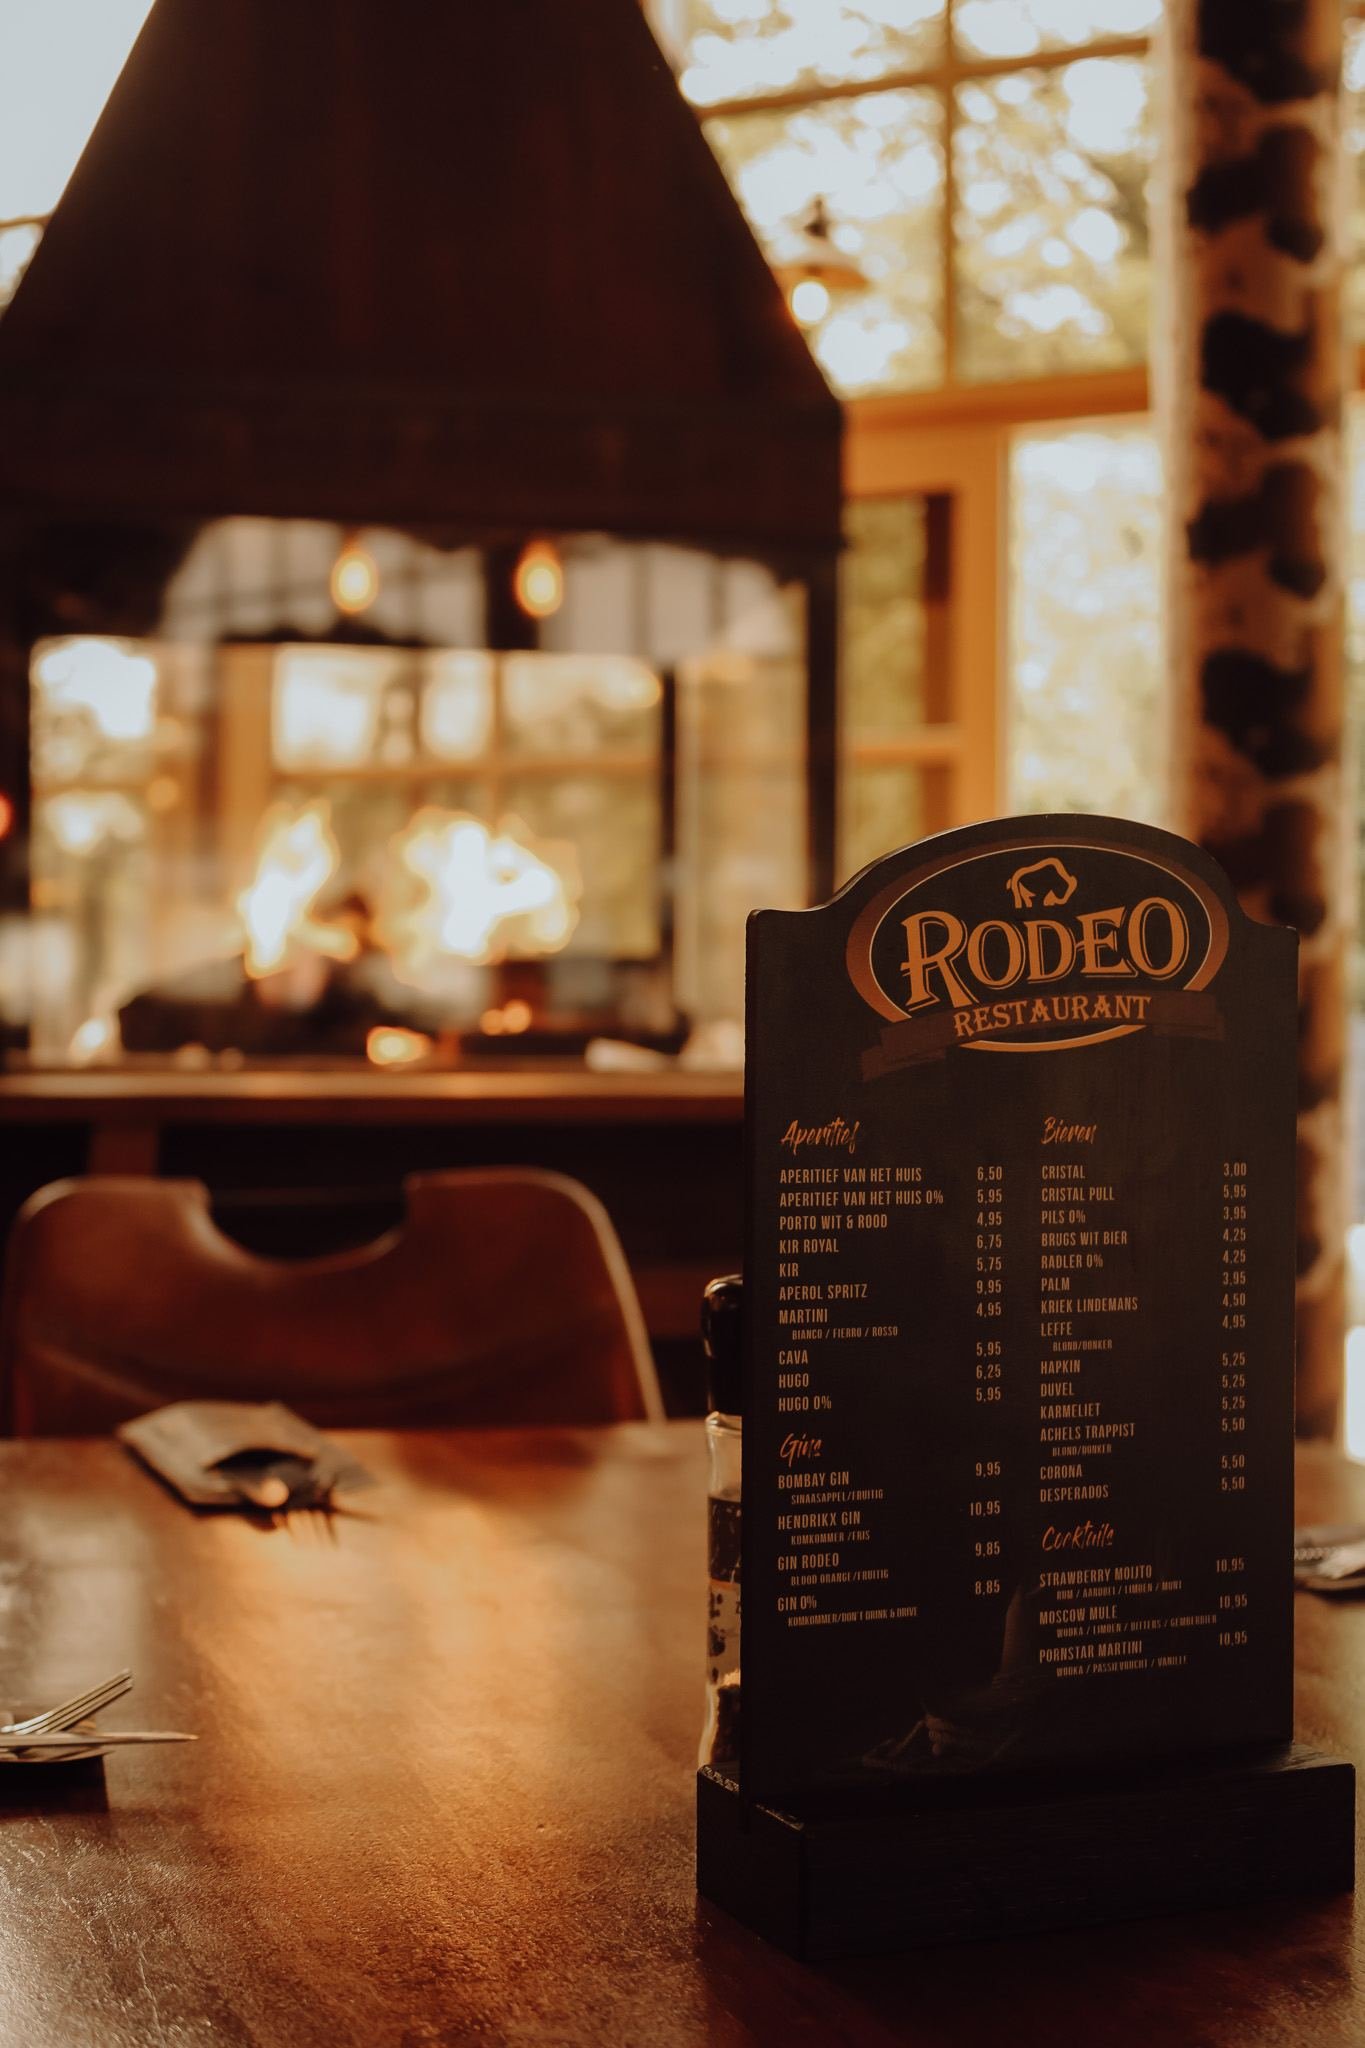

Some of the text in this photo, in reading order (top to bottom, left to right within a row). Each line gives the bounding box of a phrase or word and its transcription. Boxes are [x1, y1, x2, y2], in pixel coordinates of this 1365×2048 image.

[901, 896, 1190, 1011] RODEO
[953, 995, 1152, 1038] RESTAURANT
[780, 1117, 860, 1155] Aperitief
[1041, 1117, 1097, 1144] Bieren
[780, 1168, 922, 1184] APERITIEF VAN HET HUIS
[977, 1166, 1003, 1182] 6,50
[1042, 1165, 1085, 1180] CRISTAL
[1223, 1163, 1247, 1177] 3,00
[780, 1190, 944, 1207] APERITIEF VAN HET HUIS 0%
[977, 1188, 1002, 1204] 5,95
[1042, 1187, 1114, 1202] CRISTAL PULL
[1223, 1184, 1247, 1199] 5,95
[977, 1212, 1002, 1227] 4,95
[1041, 1209, 1086, 1224] PILS 0%
[1223, 1206, 1246, 1221] 3,95
[780, 1214, 888, 1230] PORTO WIT & ROOD
[977, 1234, 1002, 1250] 6,75
[1041, 1231, 1128, 1246] BRUGS WIT BIER
[1223, 1228, 1246, 1243] 4,25
[780, 1239, 839, 1254] KIR ROYAL
[1041, 1254, 1103, 1269] RADLER 0%
[1223, 1249, 1246, 1264] 4,25
[779, 1263, 799, 1277] KIR
[977, 1257, 1002, 1273] 5,75
[1041, 1277, 1070, 1291] PALM
[1223, 1272, 1246, 1286] 3,95
[779, 1283, 868, 1301] APEROL SPRITZ
[976, 1280, 1002, 1295] 9,95
[1041, 1297, 1138, 1314] KRIEK LINDEMANS
[1222, 1293, 1246, 1308] 4,50
[779, 1309, 828, 1324] MARTINI
[976, 1302, 1001, 1318] 4,95
[1041, 1322, 1073, 1336] LEFFE
[1222, 1315, 1246, 1329] 4,95
[792, 1329, 823, 1340] BIANCO
[872, 1326, 898, 1337] ROSSO
[779, 1350, 808, 1365] CAVA
[976, 1342, 1001, 1357] 5,95
[1041, 1360, 1081, 1375] HAPKIN
[1222, 1353, 1245, 1367] 5,25
[976, 1364, 1001, 1380] 6,25
[779, 1373, 809, 1389] HUGO
[1222, 1374, 1245, 1389] 5,25
[976, 1387, 1001, 1403] 5,95
[1040, 1382, 1074, 1397] DUVEL
[778, 1396, 832, 1412] HUGO 0%
[1040, 1403, 1101, 1420] KARMELIET
[1222, 1396, 1245, 1411] 5,25
[1040, 1423, 1136, 1442] ACHELS TRAPPIST
[1221, 1418, 1245, 1433] 5,50
[975, 1461, 1001, 1478] 9,95
[1221, 1455, 1245, 1470] 5,50
[778, 1471, 849, 1489] BOMBAY GIN
[1040, 1464, 1083, 1481] CORONA
[1221, 1476, 1245, 1491] 5,50
[1040, 1485, 1109, 1503] DESPERADOS
[969, 1501, 1001, 1517] 10,95
[778, 1511, 861, 1530] HENDRIKX GIN
[975, 1541, 1001, 1557] 9,85
[778, 1553, 840, 1571] GIN RODEO
[1216, 1557, 1244, 1574] 10,95
[1040, 1568, 1111, 1588] STRAWBERRY
[975, 1580, 1001, 1596] 8,85
[777, 1595, 817, 1612] GIN 0%
[1219, 1594, 1248, 1610] 10,95
[1040, 1605, 1118, 1626] MOSCOW MULE
[1219, 1631, 1248, 1647] 10,95
[1040, 1640, 1143, 1664] PORNSTAR MARTINI
